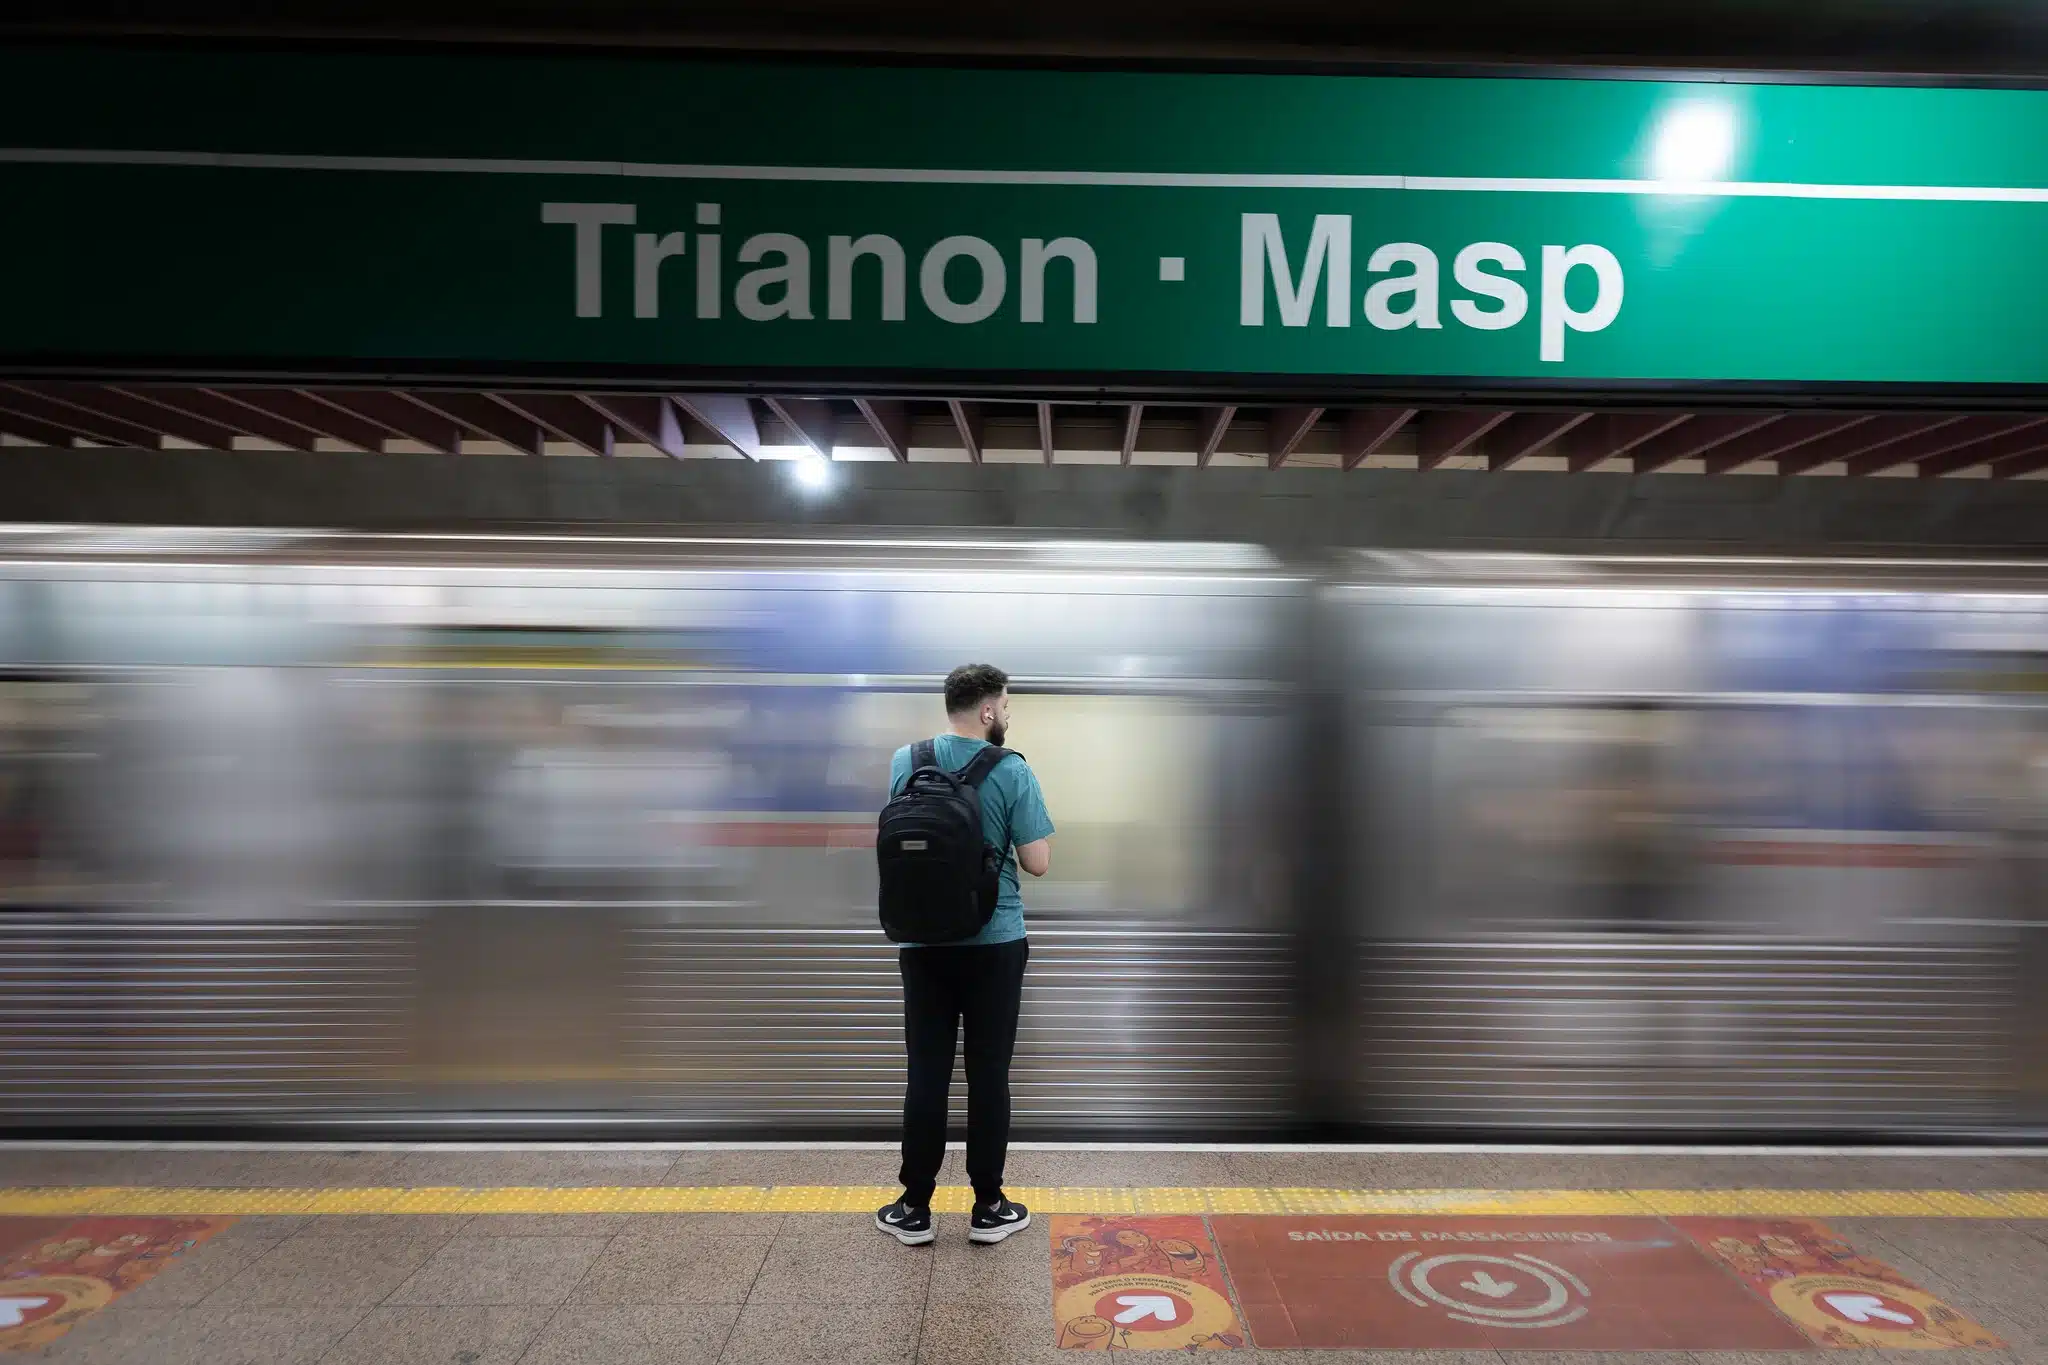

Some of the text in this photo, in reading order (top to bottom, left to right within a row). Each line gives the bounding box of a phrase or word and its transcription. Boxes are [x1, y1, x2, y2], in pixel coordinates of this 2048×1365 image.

[540, 202, 1098, 325] Trianon
[1240, 212, 1625, 362] Masp
[1376, 1230, 1416, 1242] DE
